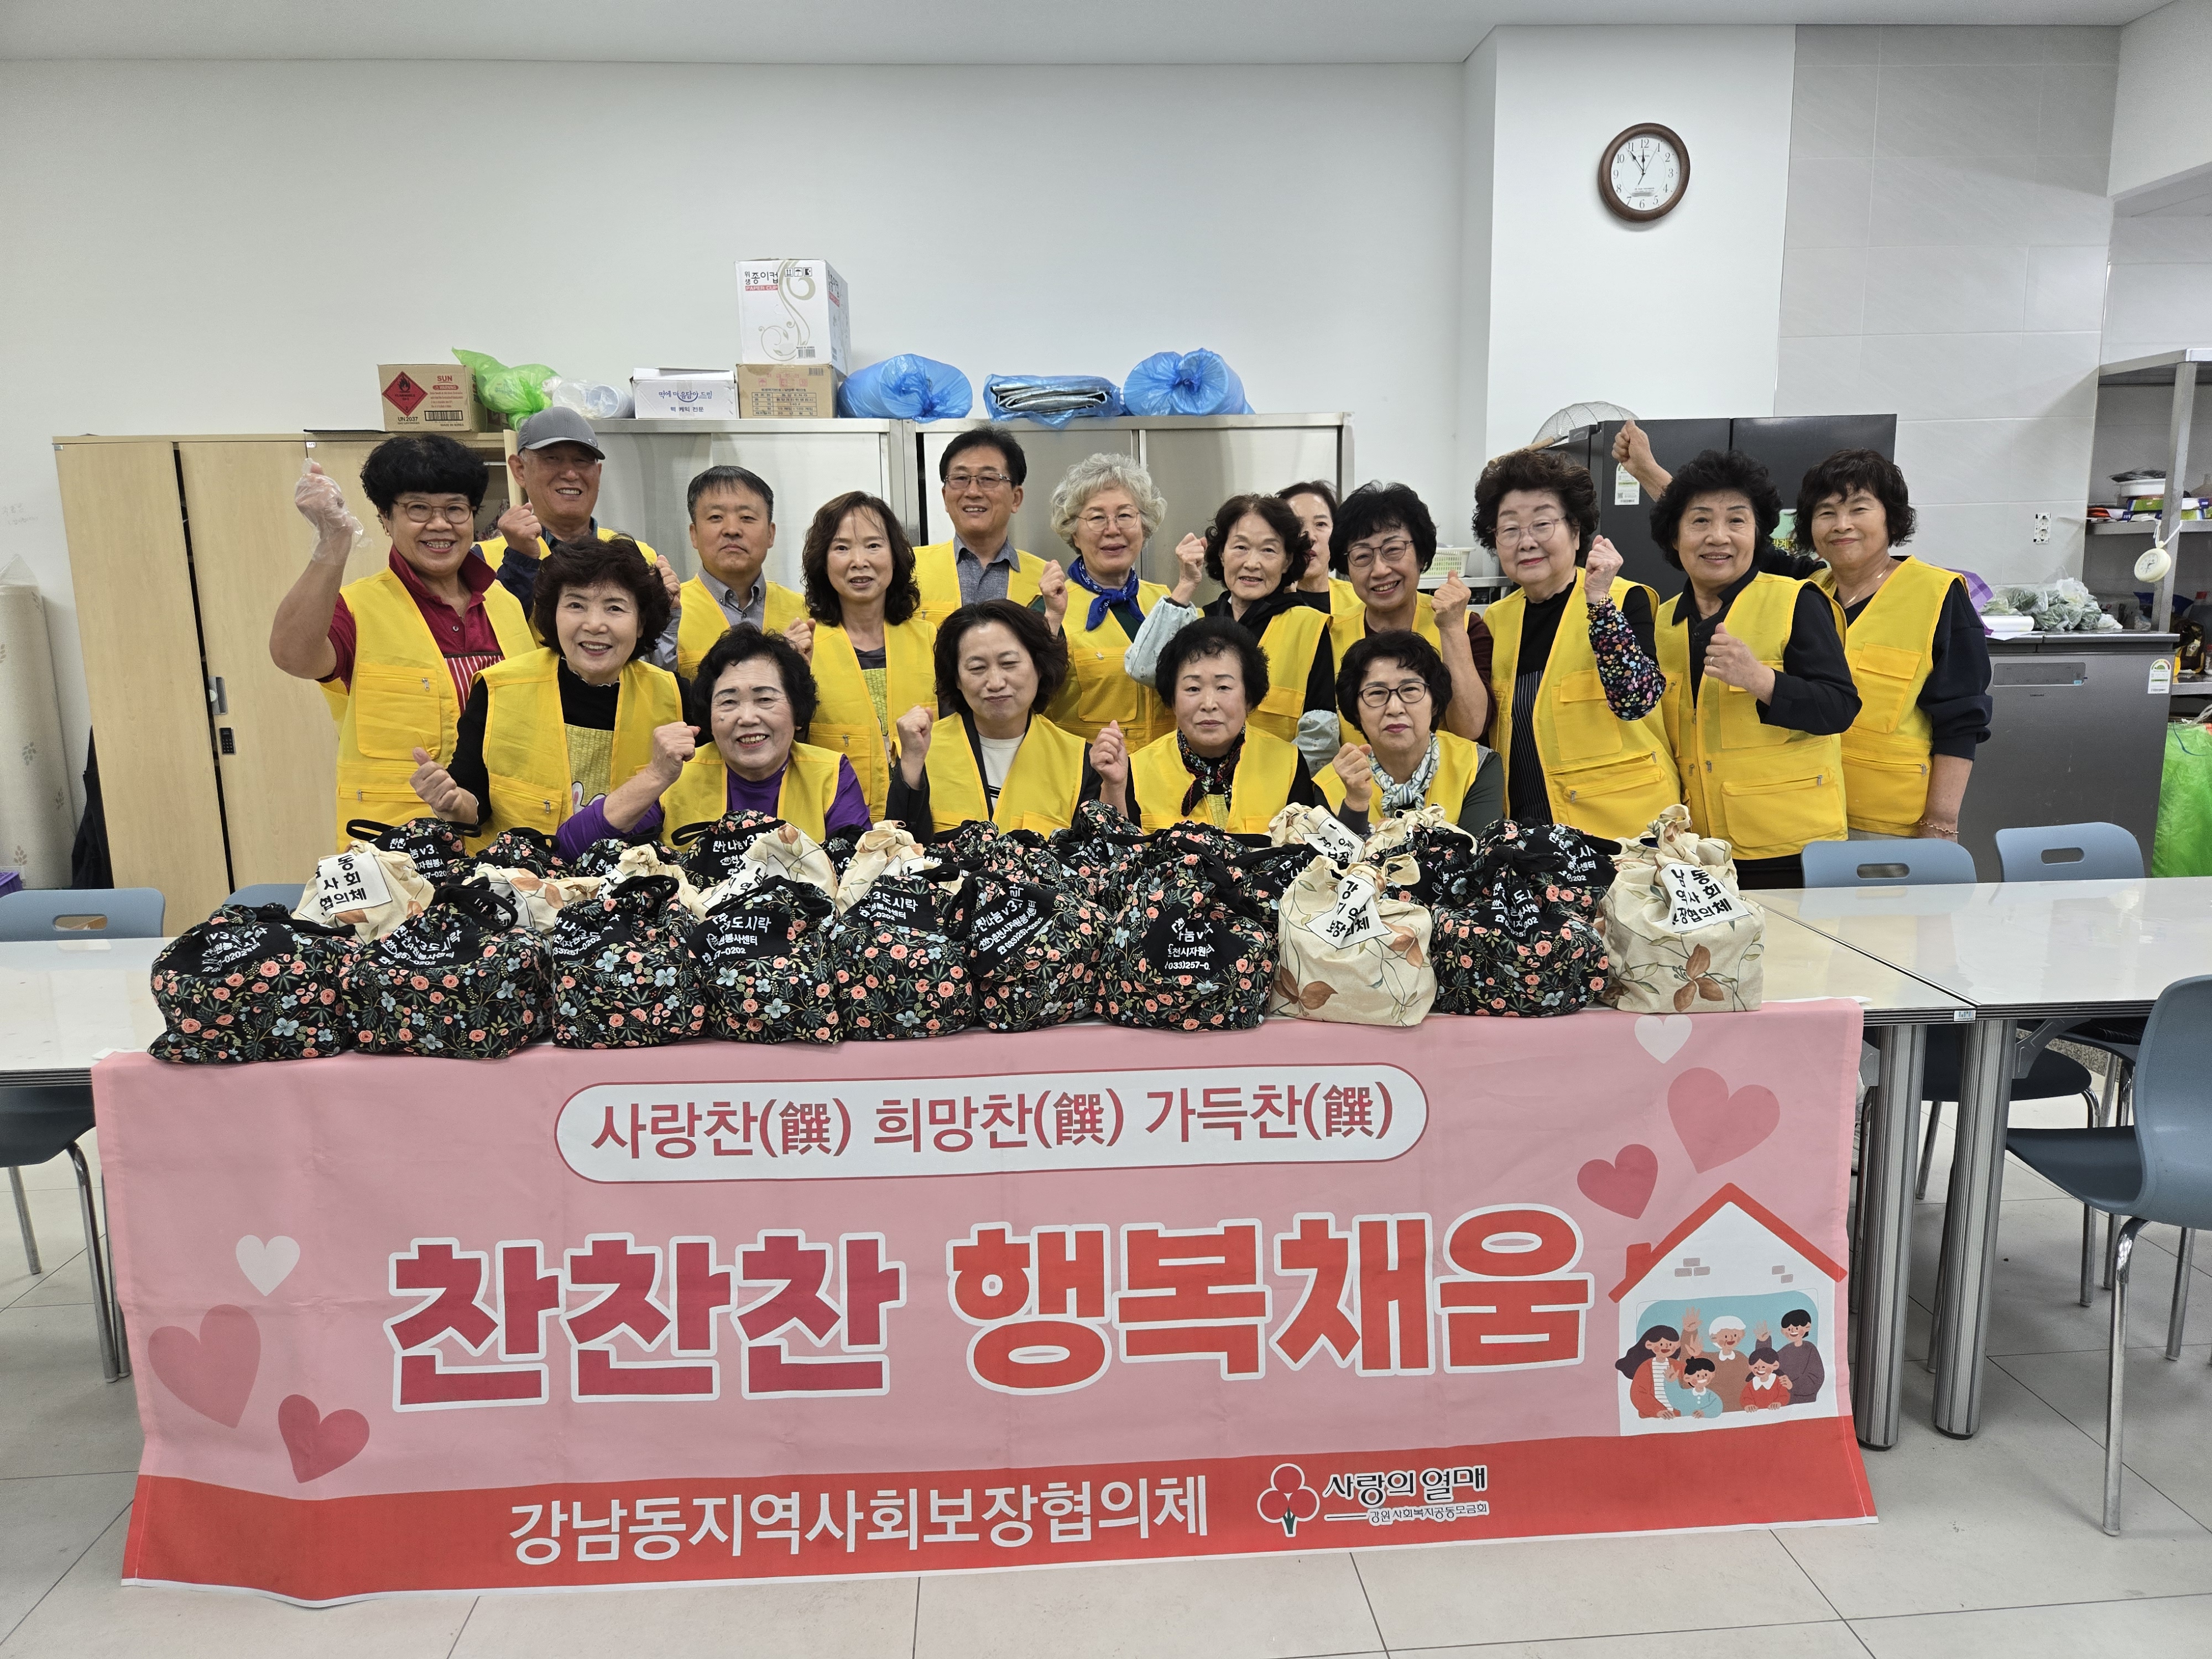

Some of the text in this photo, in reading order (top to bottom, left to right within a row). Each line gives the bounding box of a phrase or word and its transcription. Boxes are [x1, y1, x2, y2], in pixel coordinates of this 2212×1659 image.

[1628, 143, 1634, 152] 11
[1641, 139, 1649, 148] 12
[1657, 143, 1660, 152] 1
[1617, 154, 1625, 164] 10
[1665, 153, 1671, 162] 2
[1613, 169, 1619, 179] 9
[1668, 168, 1673, 178] 3
[1616, 184, 1621, 194] 8
[1663, 184, 1668, 192] 4
[1626, 196, 1631, 206] 7
[1639, 199, 1645, 208] 6
[1652, 195, 1658, 205] 5
[751, 272, 778, 284] 종이컵
[659, 390, 671, 399] 떡에
[701, 390, 712, 399] 드림
[1671, 869, 1710, 888] 남동
[1676, 883, 1721, 905] 역사회
[320, 888, 367, 911] 협의체
[882, 893, 919, 912] 도시락
[974, 900, 1018, 932] 찬나눔 v3
[731, 915, 772, 933] 도시락
[209, 931, 229, 940] v3
[426, 930, 463, 952] 도시락
[592, 1082, 1393, 1159] 사랑찬(饌) 희망찬(饌) 가득찬(饌)
[388, 1206, 1593, 1409] 찬찬찬 행복채움
[1324, 1467, 1485, 1505] 사랑의 열매
[509, 1475, 1208, 1566] 강남동지역사회보장협의체
